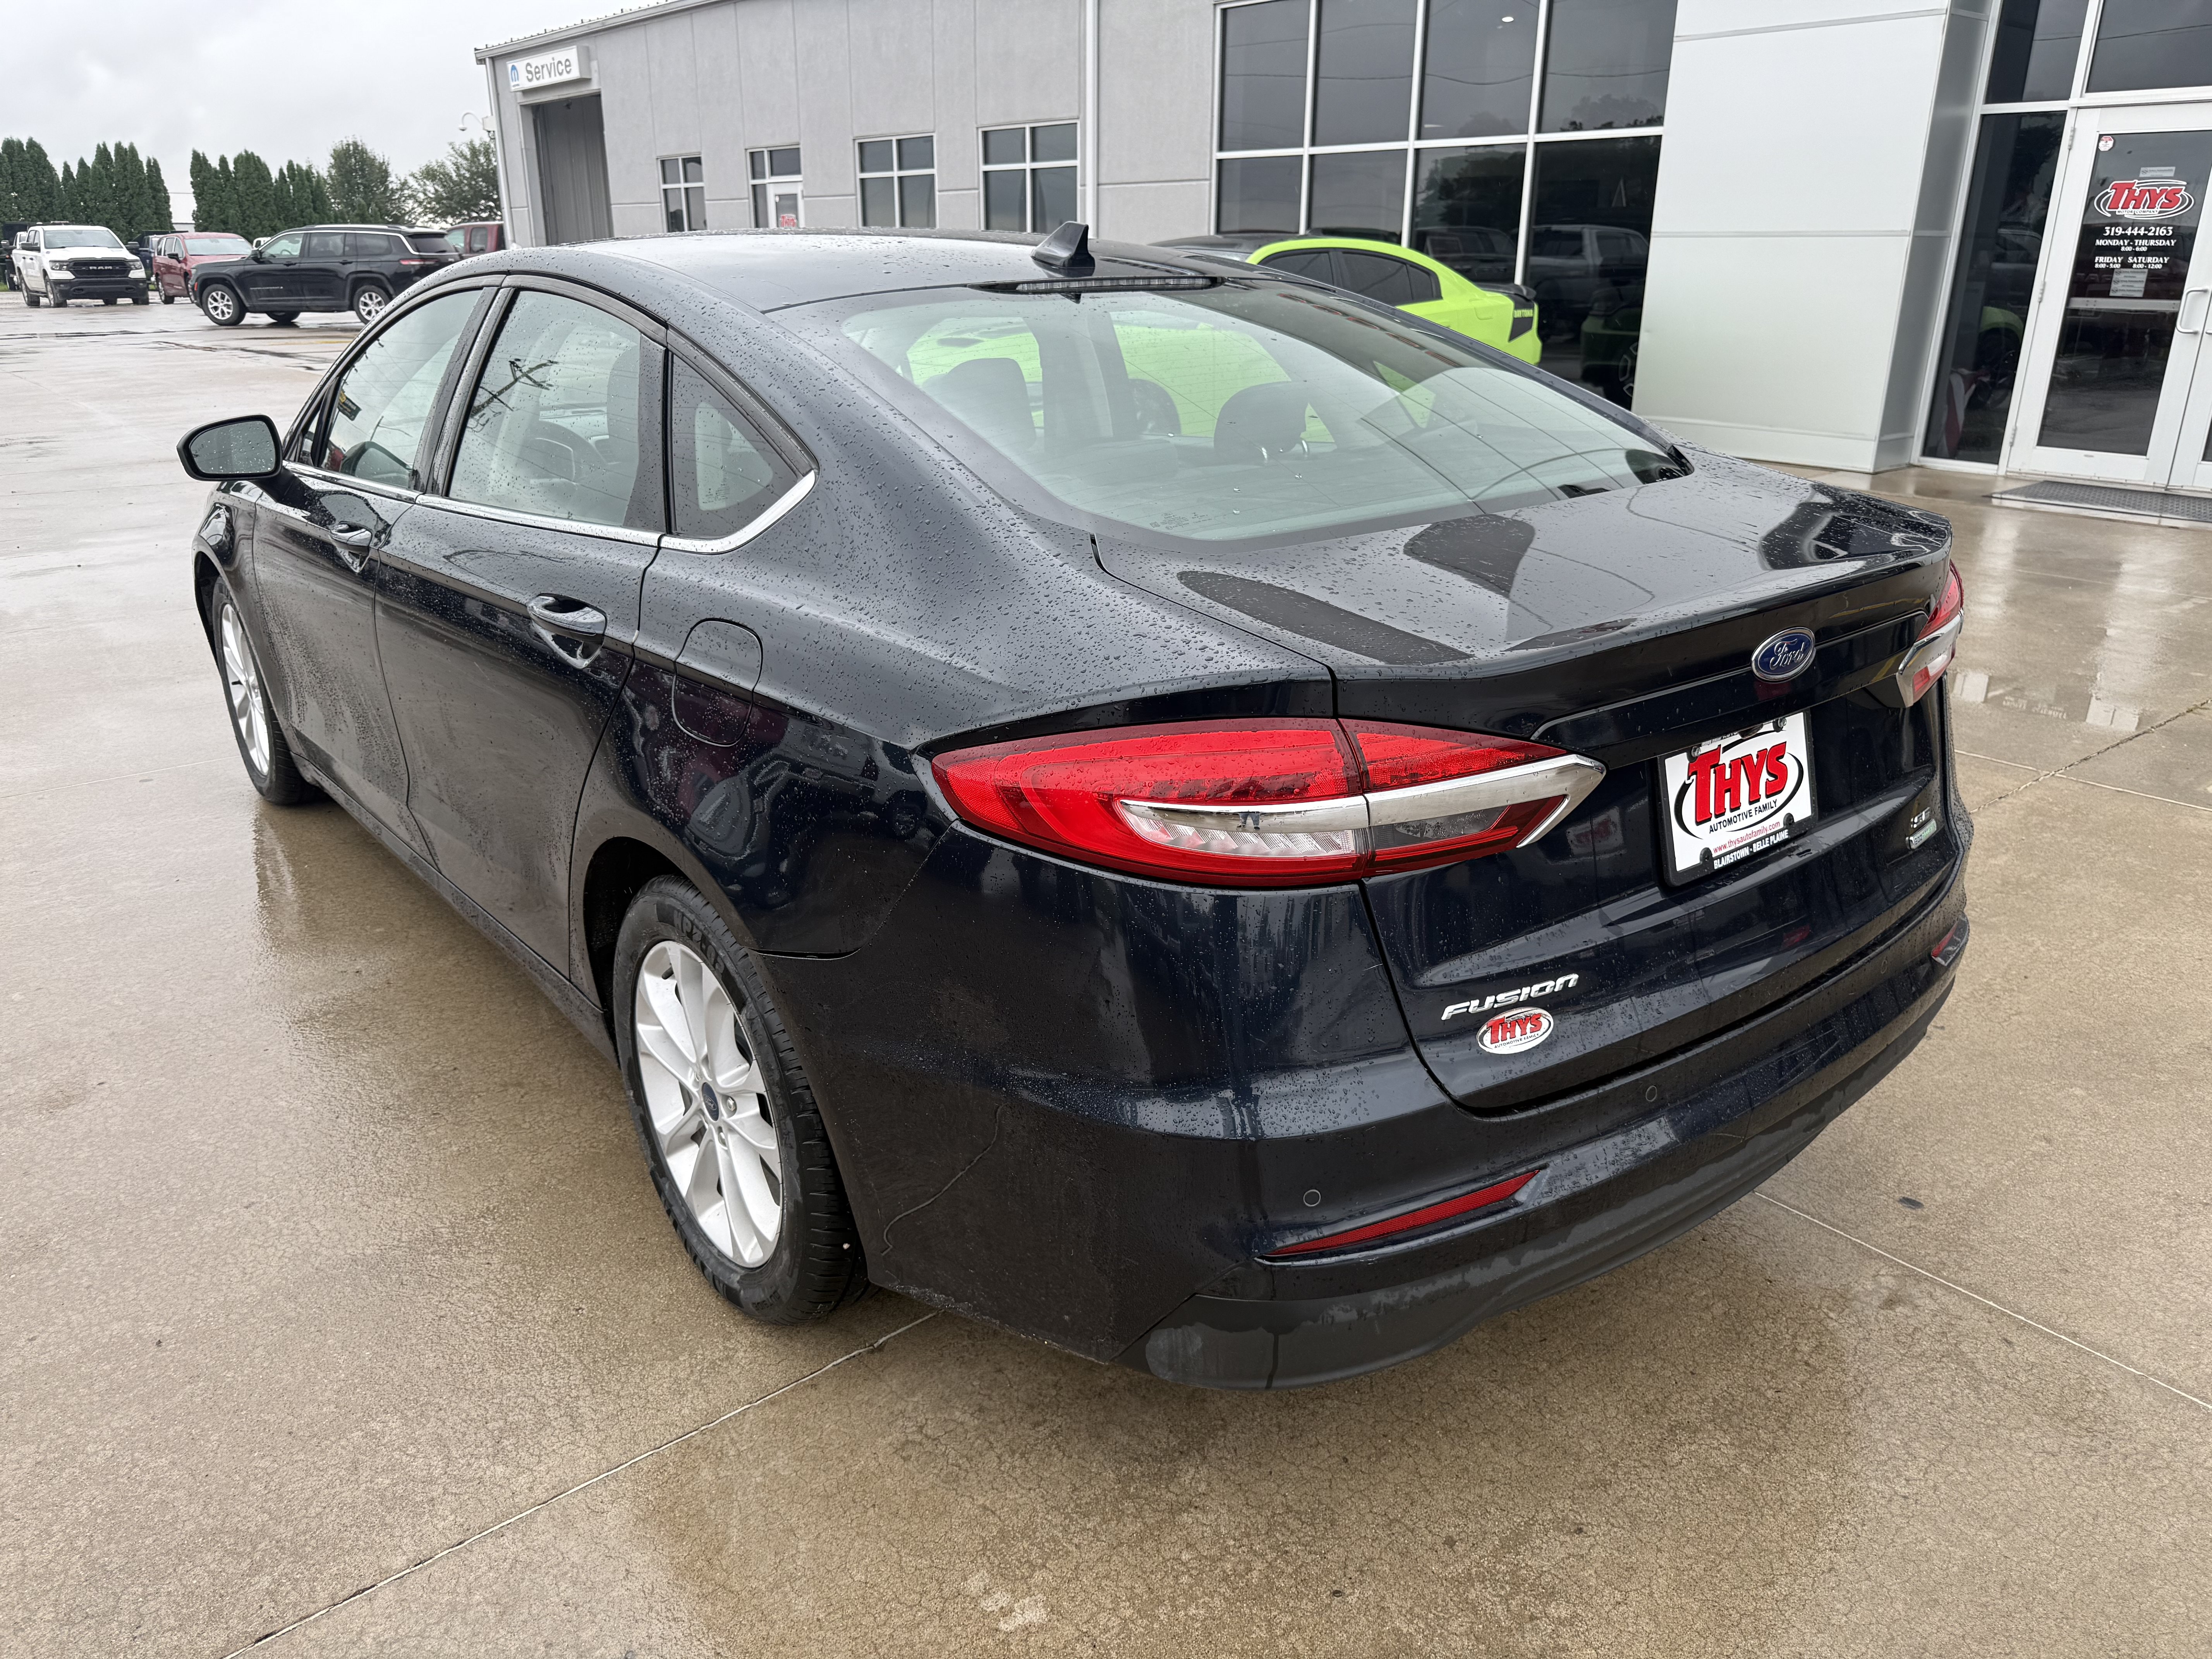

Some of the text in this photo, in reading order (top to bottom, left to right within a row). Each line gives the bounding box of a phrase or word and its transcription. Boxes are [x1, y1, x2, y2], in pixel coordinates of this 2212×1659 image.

[526, 57, 572, 82] Service
[2107, 182, 2184, 210] THYS
[2103, 227, 2173, 236] 319-444-2163
[1769, 638, 1805, 670] Ford
[1687, 741, 1788, 826] THYS
[1709, 799, 1778, 834] AUTOMOTIVE FAMILY
[1713, 821, 1781, 854] www.thysautofamily.com
[1714, 846, 1750, 869] BLAIRSTOWN
[1752, 838, 1770, 852] BELLE
[1769, 829, 1788, 846] PLAINE
[1441, 973, 1579, 1020] FUSION
[1487, 1013, 1542, 1044] THYS
[1494, 1038, 1522, 1048] AUTOMOTIVE
